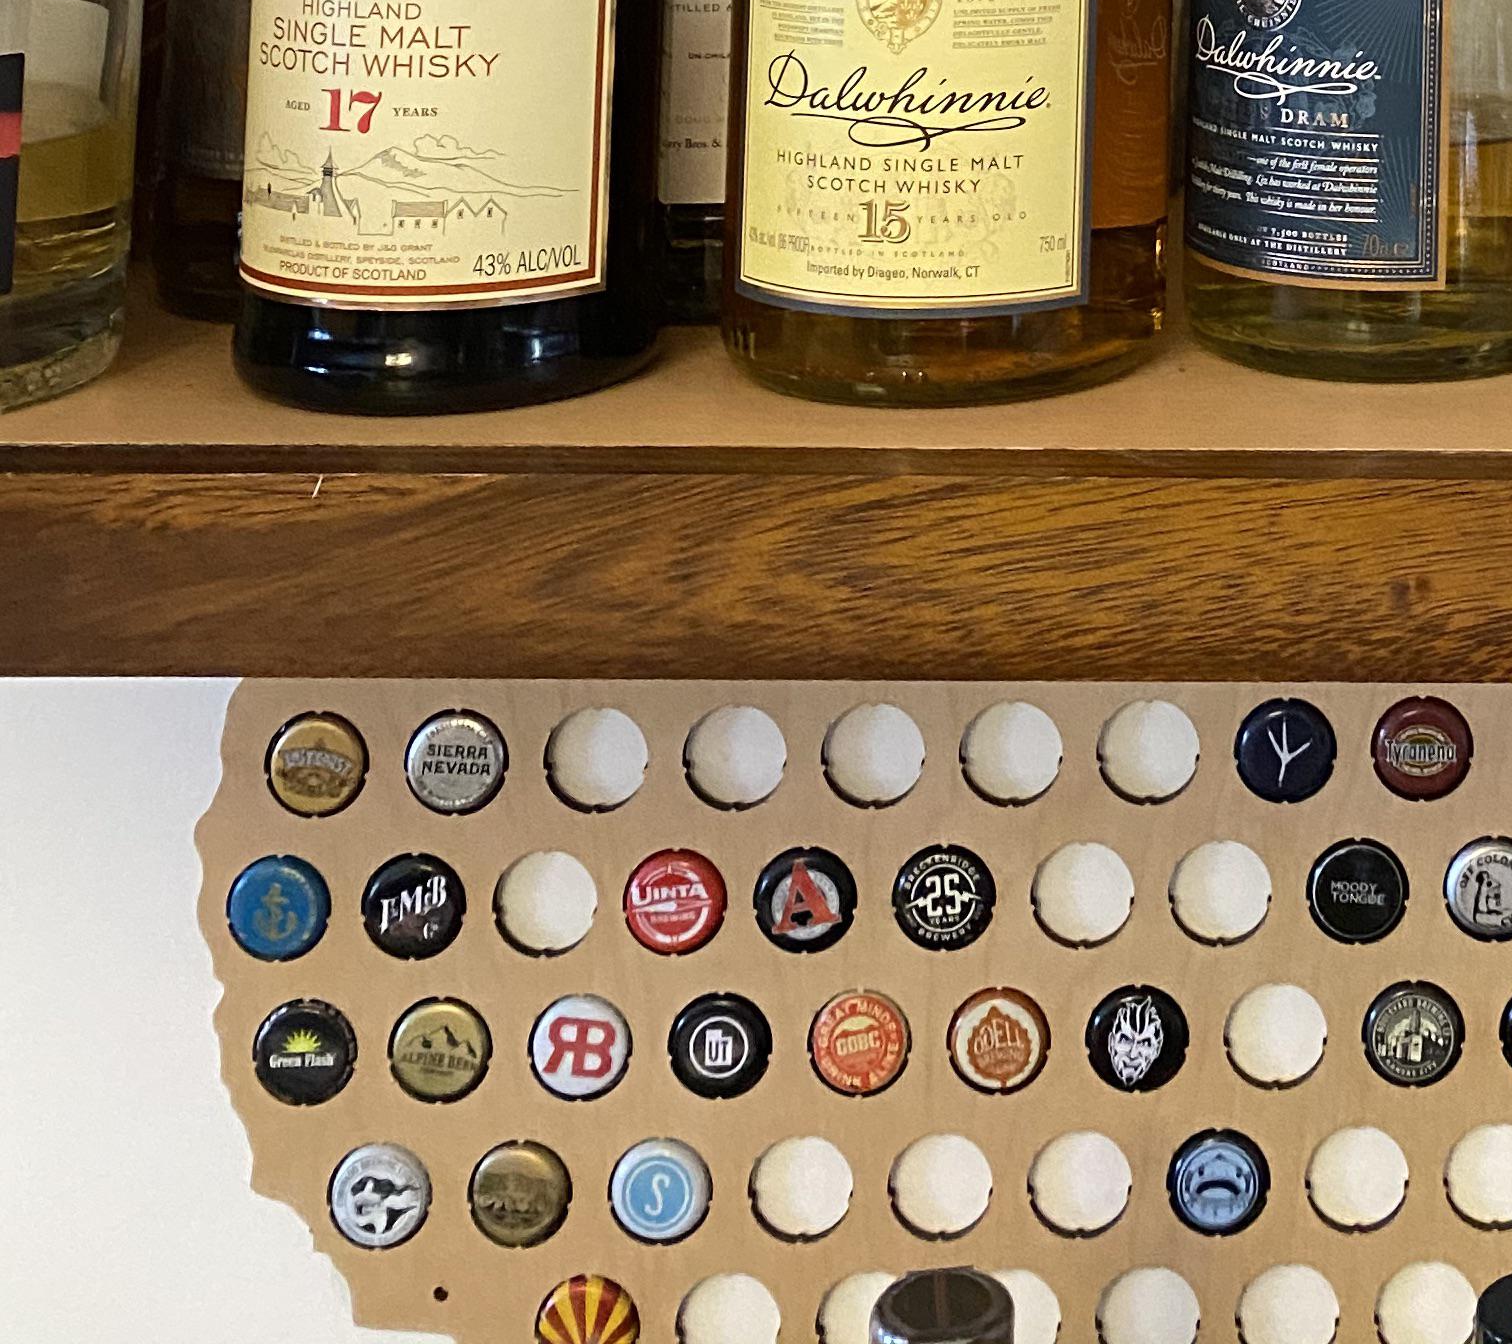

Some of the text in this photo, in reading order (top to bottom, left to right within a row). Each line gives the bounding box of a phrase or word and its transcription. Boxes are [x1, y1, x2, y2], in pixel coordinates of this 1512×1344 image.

[273, 17, 471, 49] SINGLE MALT
[1195, 14, 1382, 82] Dalwhinnie
[259, 42, 500, 78] SCOTCH WHISKY
[765, 49, 1051, 118] Dalwhinnie
[285, 88, 438, 134] AGED 17 YEARS
[1281, 108, 1349, 128] DRAM
[1281, 137, 1378, 152] SCOTCH WHISKY
[777, 151, 1025, 173] HIGHLAND SINGLE MALT
[807, 176, 982, 195] SCOTCH WHISKY
[858, 199, 911, 244] 15
[352, 268, 426, 281] SCOTLAND
[473, 252, 512, 277] 43%
[966, 265, 980, 278] CT
[427, 744, 488, 760] SIERRA
[421, 761, 490, 776] NEVADA
[904, 855, 981, 890] BRECKENRIDGE
[631, 882, 708, 905] UINTA
[926, 874, 960, 913] 25
[1331, 880, 1377, 893] MOODY
[270, 1053, 335, 1068] Green Flash
[708, 1041, 729, 1063] UT
